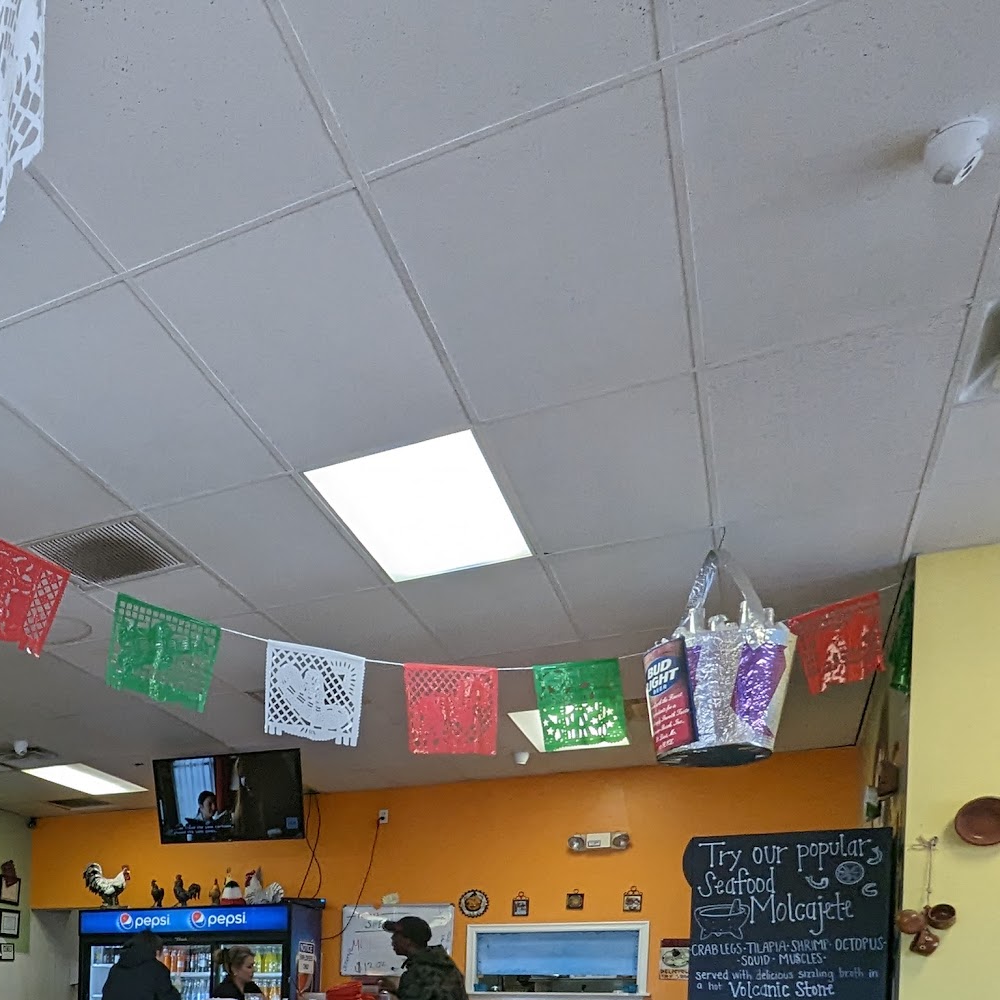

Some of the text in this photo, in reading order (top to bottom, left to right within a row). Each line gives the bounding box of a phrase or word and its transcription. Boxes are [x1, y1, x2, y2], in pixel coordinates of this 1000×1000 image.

[646, 666, 679, 692] LIGHT
[647, 658, 672, 680] BUD
[698, 834, 872, 872] Try our popular
[697, 866, 776, 897] Seafood
[135, 911, 246, 929] pepsi pepsi
[750, 892, 854, 935] Molcajete
[691, 936, 884, 956] CRAB LEGS TILAPIA SHRIMP OCTOPUS
[741, 952, 823, 966] SQUID MUSCLES
[695, 969, 729, 980] served
[732, 969, 752, 980] with
[756, 968, 794, 980] delicious
[798, 968, 835, 983] sizzling
[838, 967, 864, 979] broth
[868, 969, 879, 978] in
[708, 981, 722, 990] hot
[728, 981, 790, 998] Volcanic
[795, 980, 835, 997] Stone
